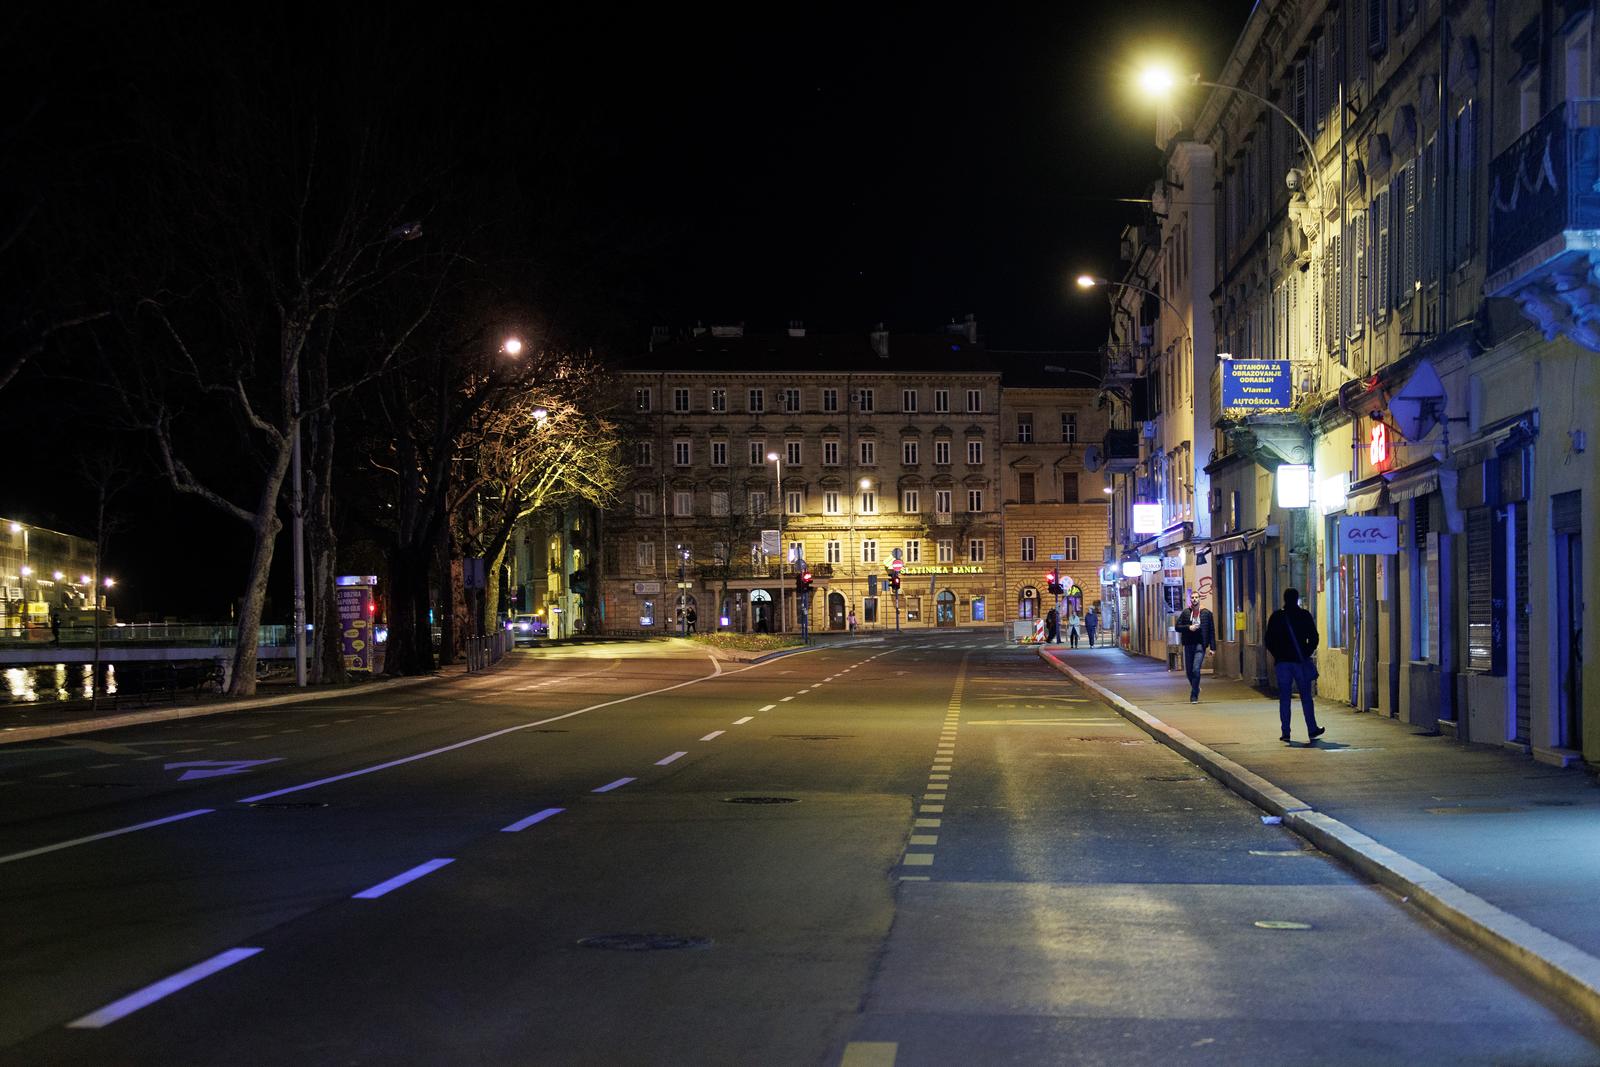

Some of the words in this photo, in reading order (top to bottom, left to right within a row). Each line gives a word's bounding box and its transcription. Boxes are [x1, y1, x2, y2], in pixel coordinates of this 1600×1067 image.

[1233, 397, 1280, 405] AUTOŠKOLA
[1348, 528, 1392, 539] ara
[900, 566, 948, 574] SLATINSKA
[952, 566, 984, 574] BANKA
